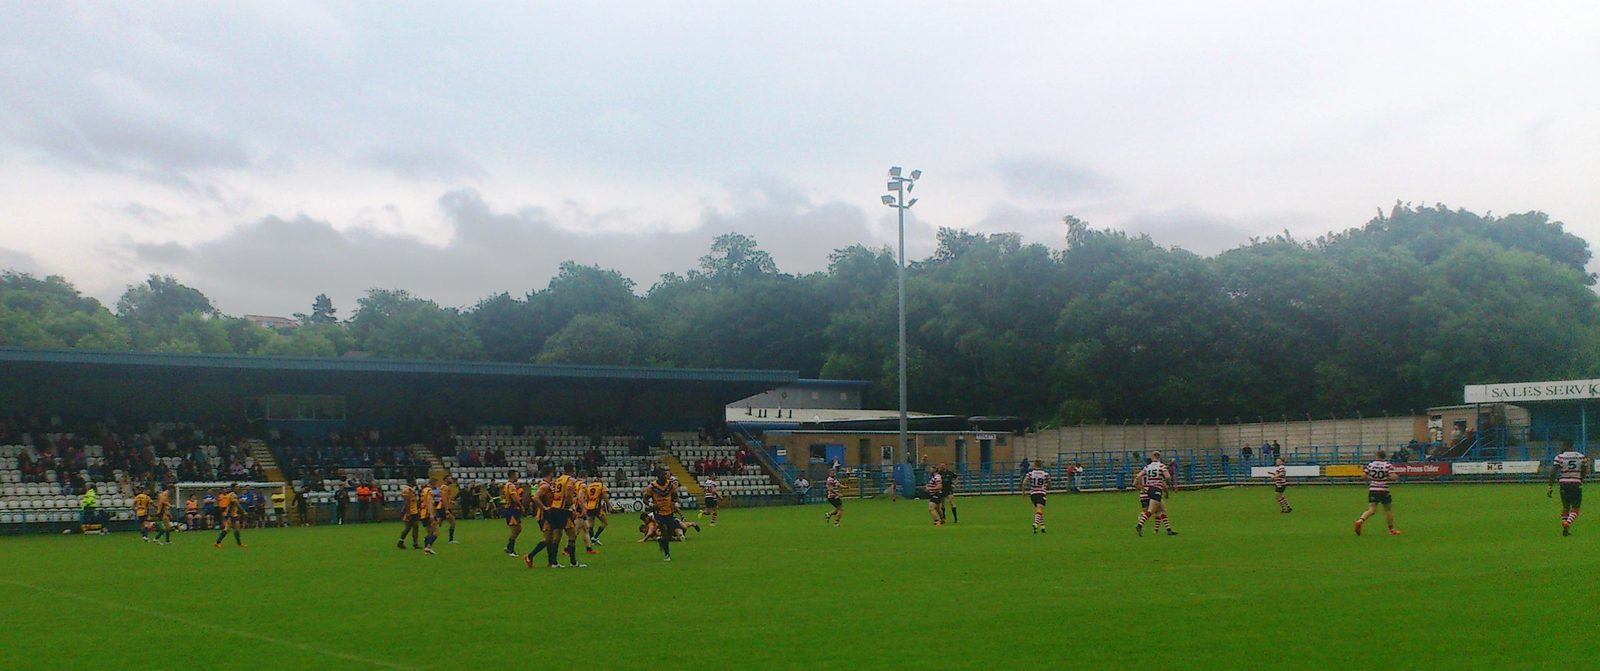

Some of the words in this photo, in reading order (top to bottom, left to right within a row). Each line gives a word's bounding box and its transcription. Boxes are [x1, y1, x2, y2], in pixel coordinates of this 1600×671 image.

[1491, 386, 1541, 398] SALES
[1568, 460, 1576, 470] 5
[1148, 469, 1157, 477] 15
[1372, 470, 1385, 479] 20
[1032, 477, 1044, 486] 18
[590, 488, 596, 496] 9
